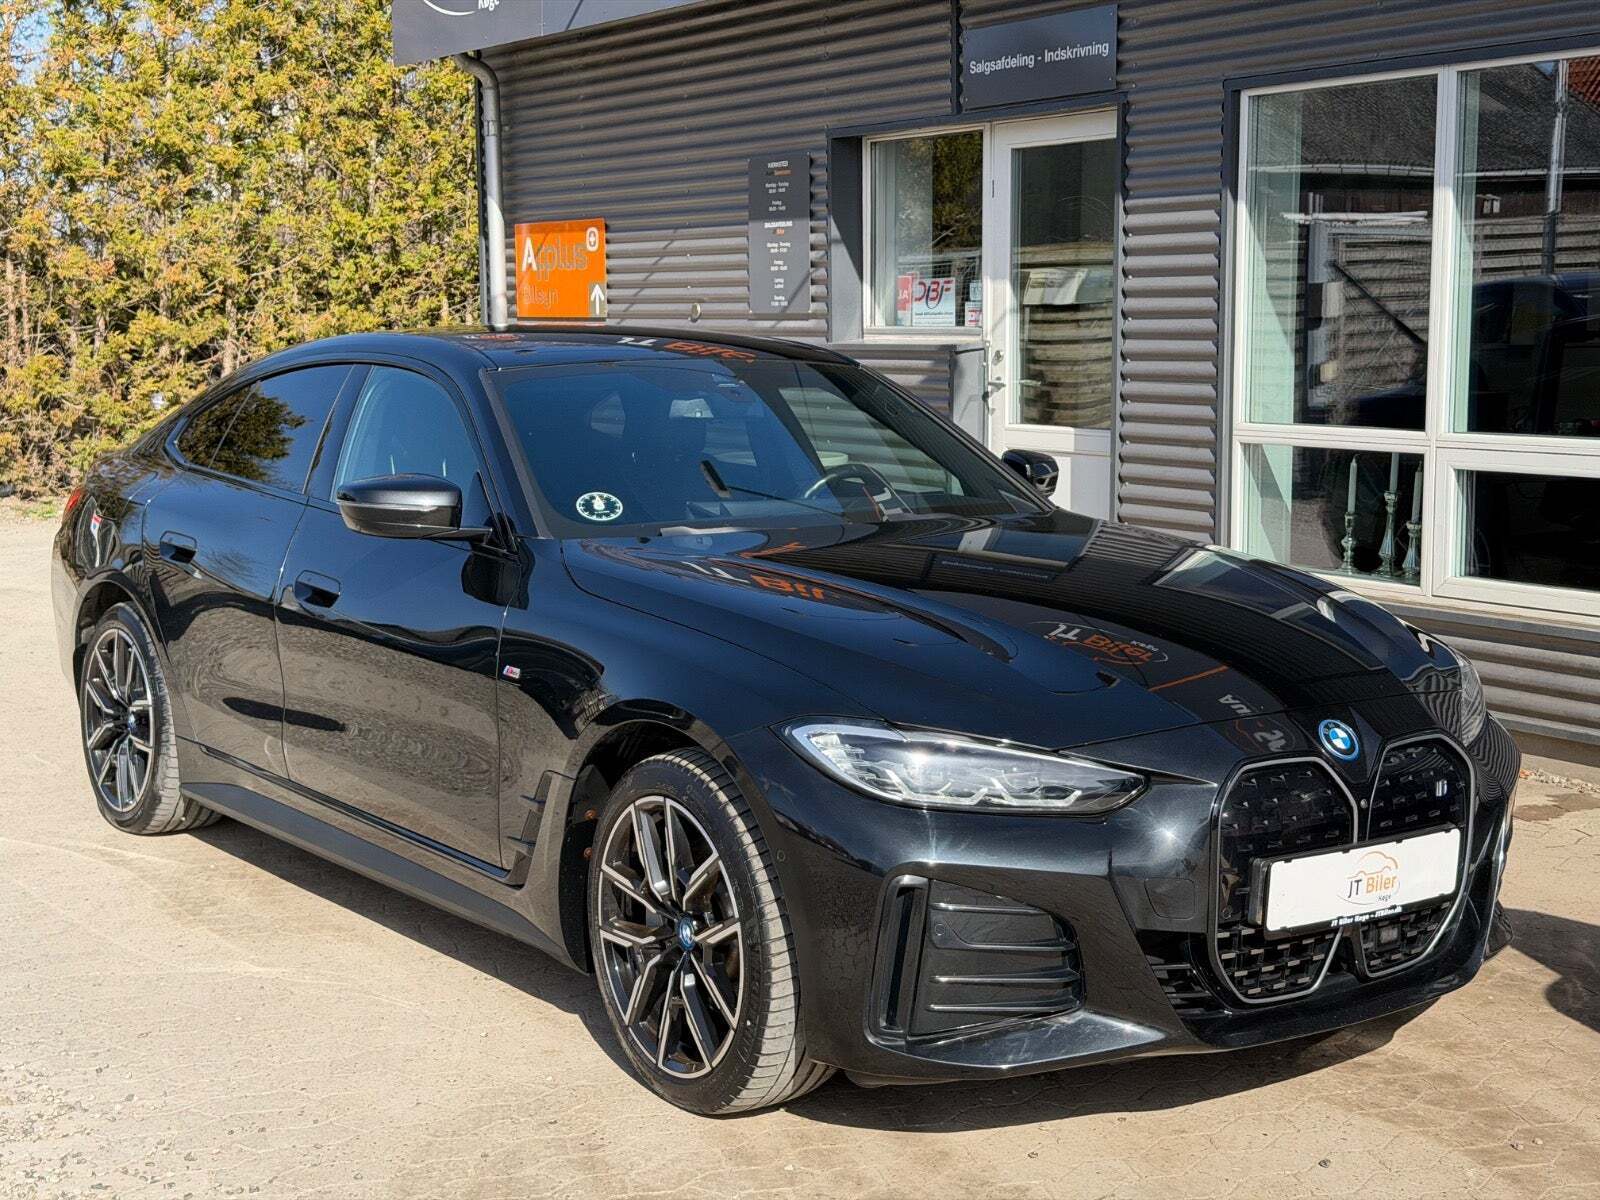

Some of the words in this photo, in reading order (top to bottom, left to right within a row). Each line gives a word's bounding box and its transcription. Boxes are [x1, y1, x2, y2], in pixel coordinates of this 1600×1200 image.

[969, 53, 1035, 75] Salgsafdeling
[1044, 41, 1109, 64] Indskrivning
[1347, 879, 1363, 898] JT
[1366, 874, 1397, 894] Biler
